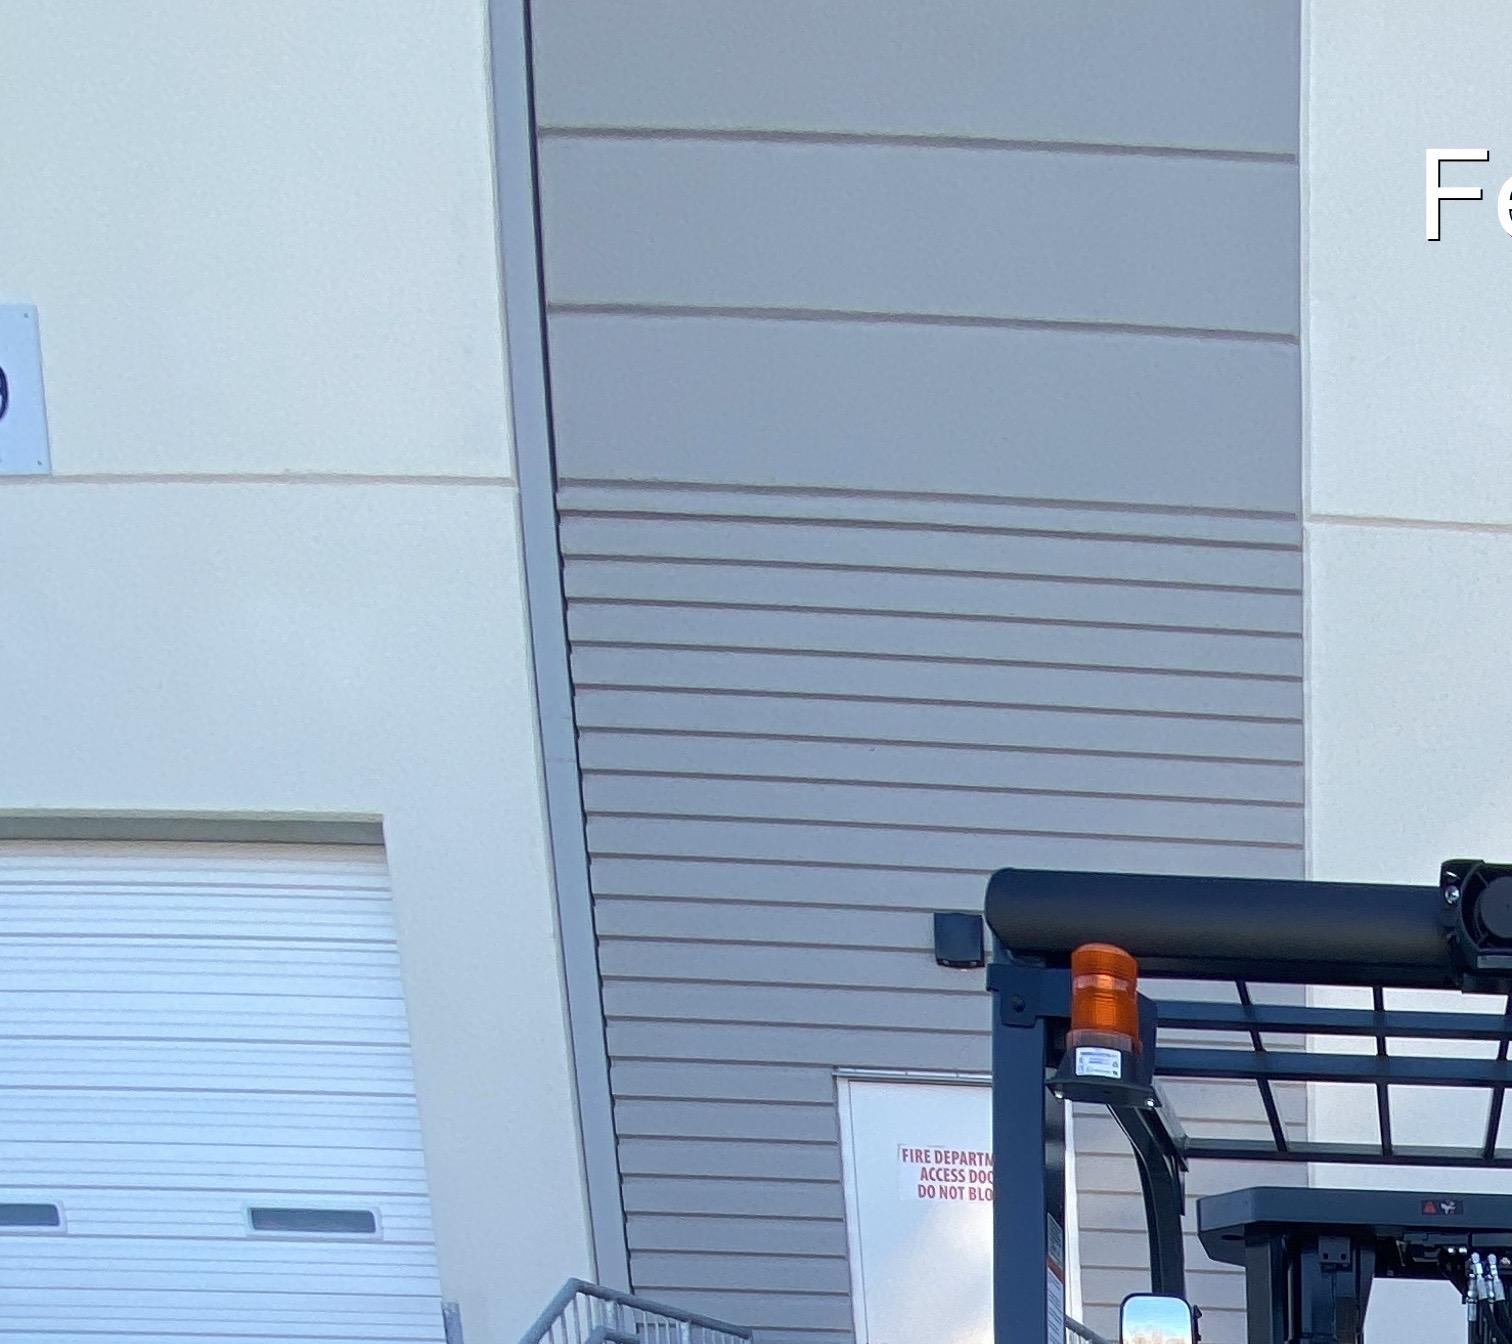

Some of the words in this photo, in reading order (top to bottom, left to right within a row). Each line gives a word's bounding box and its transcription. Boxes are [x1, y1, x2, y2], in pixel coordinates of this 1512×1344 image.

[902, 1148, 932, 1164] FIRE
[920, 1167, 966, 1183] ACCESS
[917, 1184, 937, 1199] DO
[939, 1185, 965, 1201] NOT
